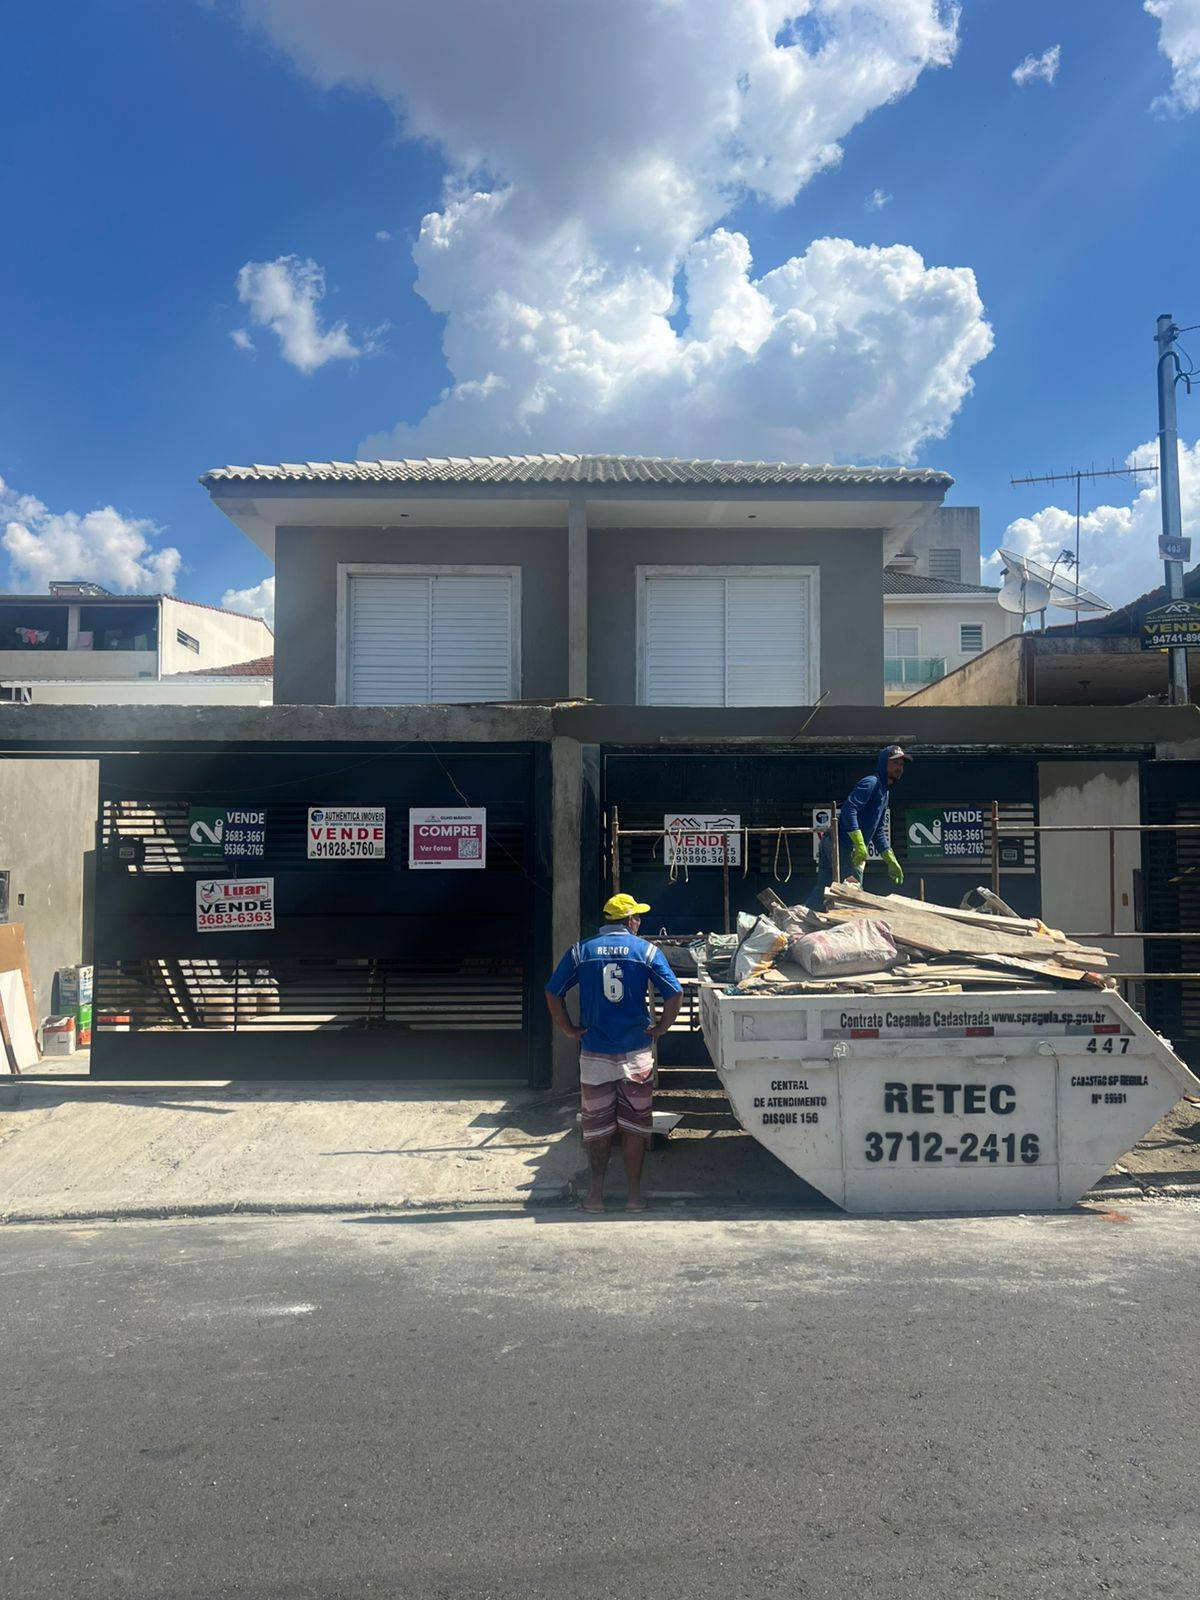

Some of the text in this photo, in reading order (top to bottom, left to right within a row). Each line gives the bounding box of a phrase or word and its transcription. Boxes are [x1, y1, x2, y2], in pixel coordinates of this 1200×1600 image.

[226, 812, 265, 824] VENDE
[943, 811, 983, 823] VENDE
[225, 830, 265, 842] 3683-3661
[310, 828, 384, 840] VENDE
[419, 825, 477, 837] COMPRE
[944, 829, 984, 841] 3683-3661
[224, 844, 264, 856] 95366-2765
[316, 841, 374, 857] 91828-5760
[944, 843, 984, 855] 95366-2765
[223, 885, 267, 897] Luar
[199, 899, 273, 914] VENDE
[199, 911, 273, 925] 3683-6363
[603, 963, 624, 1002] 6
[885, 1011, 931, 1029] Caçamba
[933, 1011, 990, 1027] Cadastrada
[1086, 1038, 1130, 1054] 447
[771, 1080, 809, 1091] CENTRAL
[1108, 1075, 1119, 1085] SP
[753, 1096, 827, 1108] DE ATENDIMENTO
[884, 1082, 1016, 1115] RETEC
[762, 1113, 819, 1124] DISQUE 156
[865, 1131, 1040, 1164] 3712-2416
